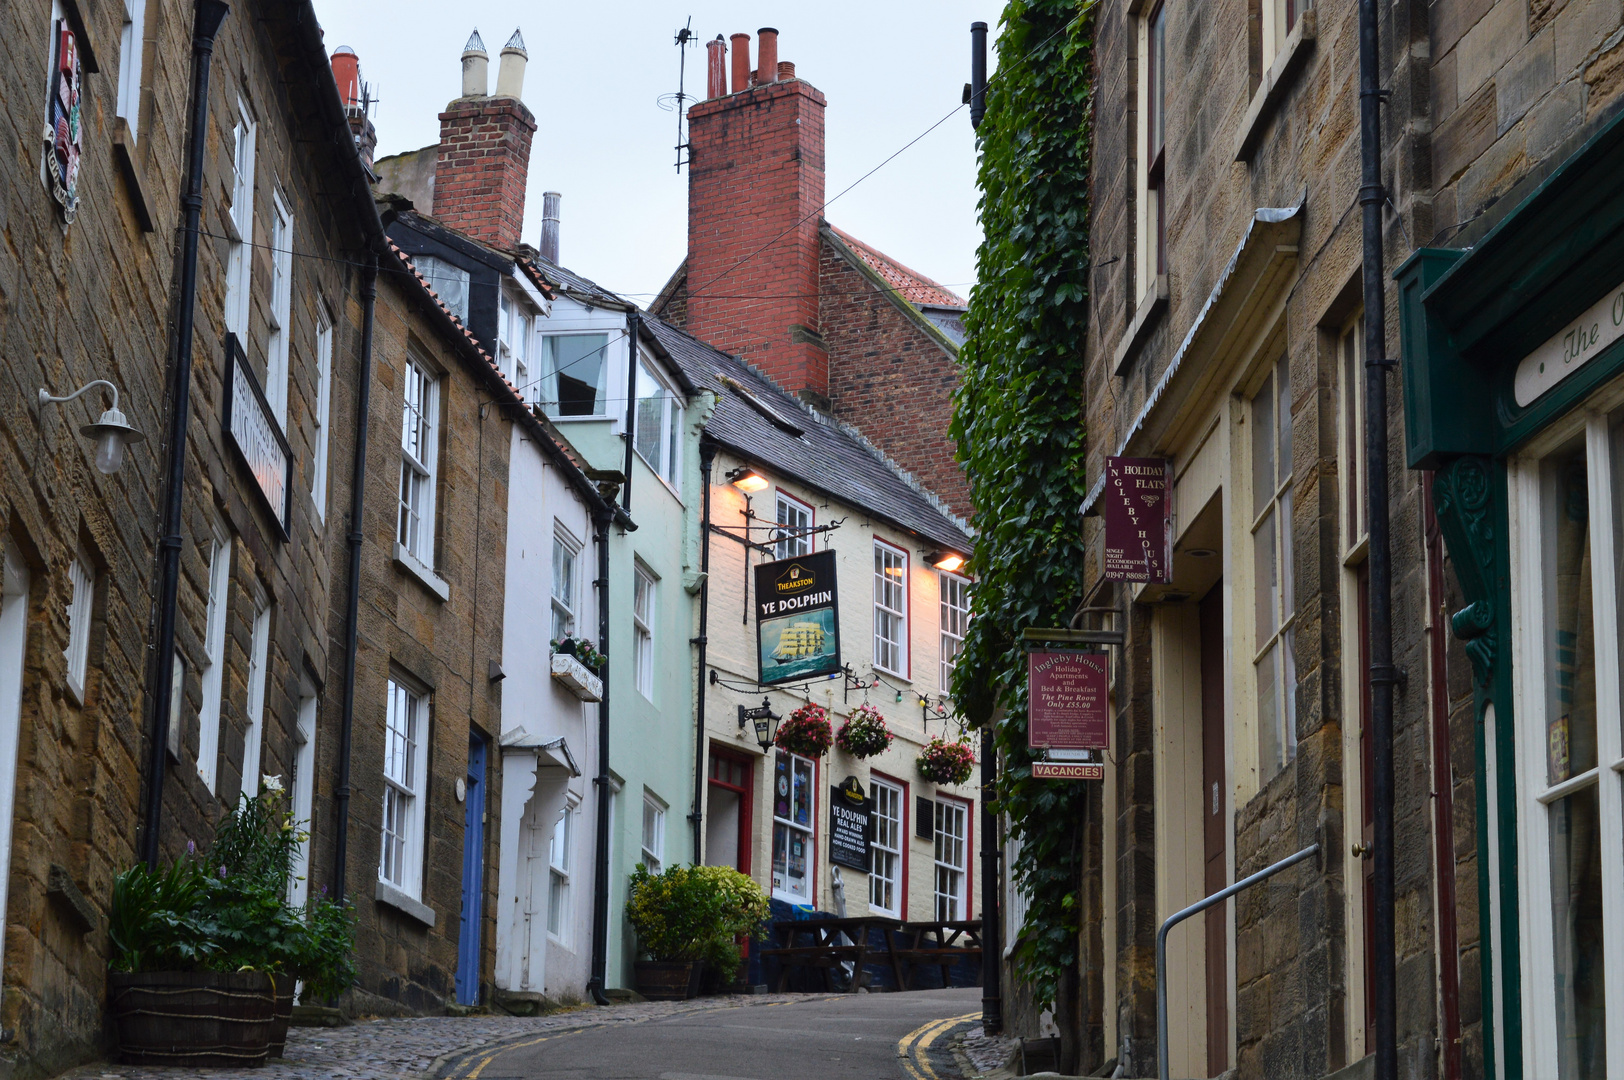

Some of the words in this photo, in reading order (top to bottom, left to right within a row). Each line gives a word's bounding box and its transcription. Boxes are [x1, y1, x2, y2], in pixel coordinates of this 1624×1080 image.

[1564, 323, 1600, 364] The
[271, 436, 282, 470] BAY
[1124, 466, 1164, 476] HOLIDAY
[1136, 480, 1165, 489] FLATS
[1108, 460, 1139, 524] INGLEBY
[1138, 530, 1162, 578] HOUSE
[778, 578, 813, 591] THEAKSTON
[762, 601, 776, 615] YE
[780, 590, 832, 612] DOLPHIN
[1035, 654, 1071, 673] Ingleby
[1076, 654, 1104, 674] House
[1047, 701, 1064, 709] Only
[1037, 766, 1099, 776] VACANCIES
[832, 805, 840, 816] YE
[841, 807, 867, 826] DOLPHIN
[837, 818, 849, 828] REAL
[850, 822, 862, 832] ALES
